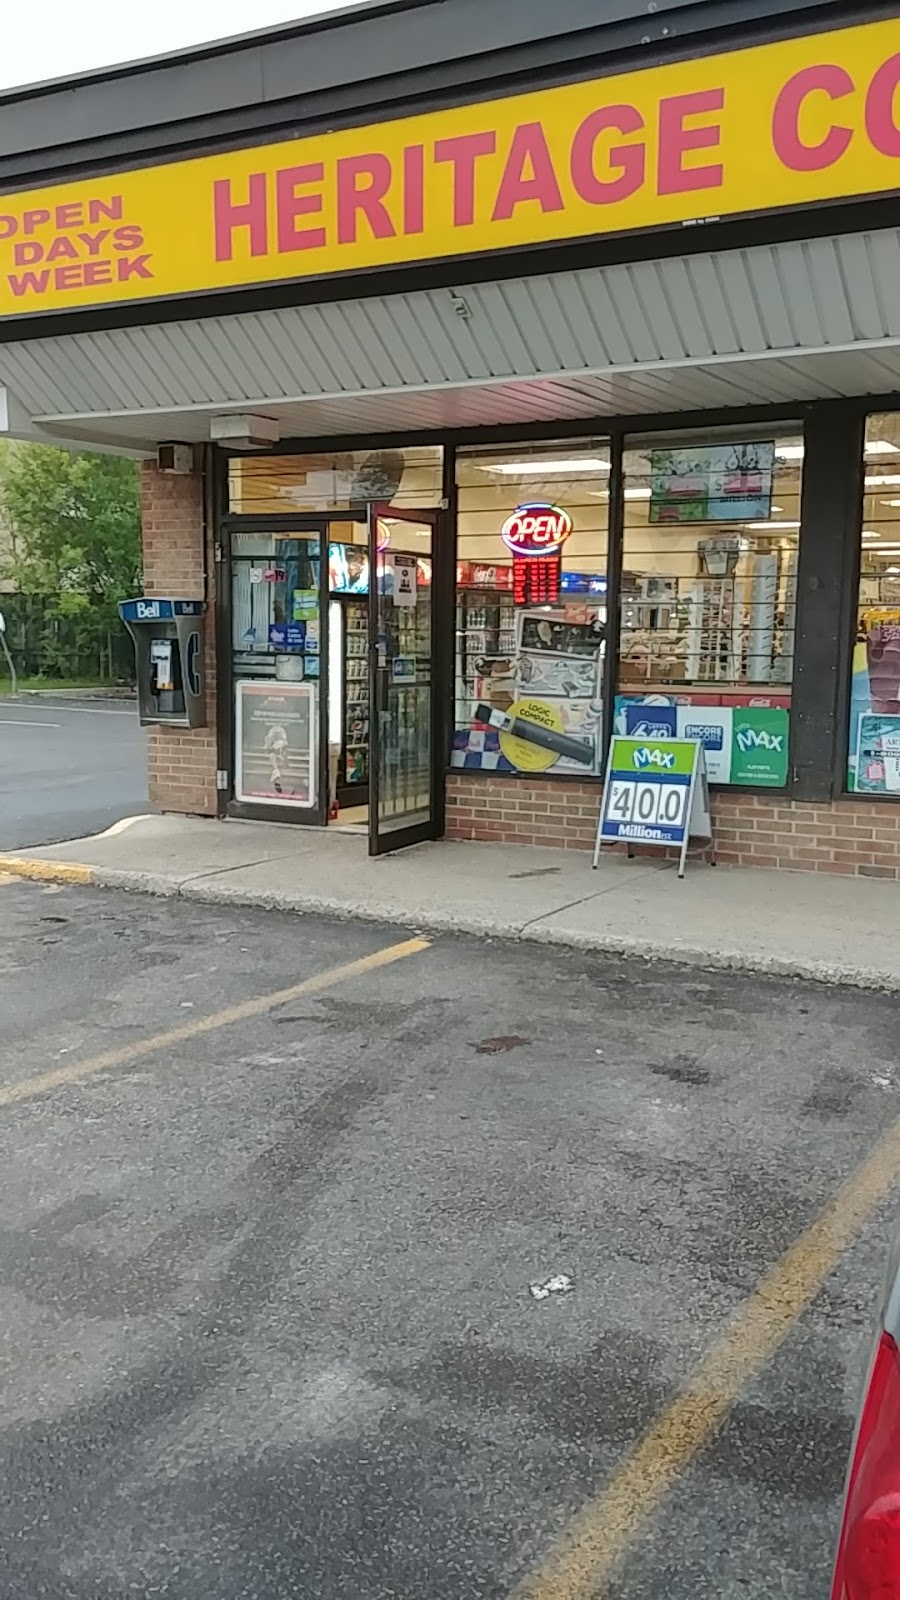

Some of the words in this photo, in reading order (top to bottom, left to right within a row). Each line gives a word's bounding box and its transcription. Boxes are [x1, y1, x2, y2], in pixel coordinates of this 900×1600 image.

[213, 88, 725, 262] HERITAGE
[0, 195, 122, 239] OPEN
[14, 225, 144, 266] DAYS
[7, 253, 154, 296] WEEK
[508, 516, 564, 542] OPEN
[136, 601, 160, 618] Bell
[182, 602, 194, 613] Bell
[520, 708, 555, 727] COMPACT
[528, 703, 550, 717] LOGIC
[686, 726, 722, 735] ENCORE
[736, 728, 783, 752] MAX
[632, 747, 674, 769] MAX
[618, 824, 661, 839] Million
